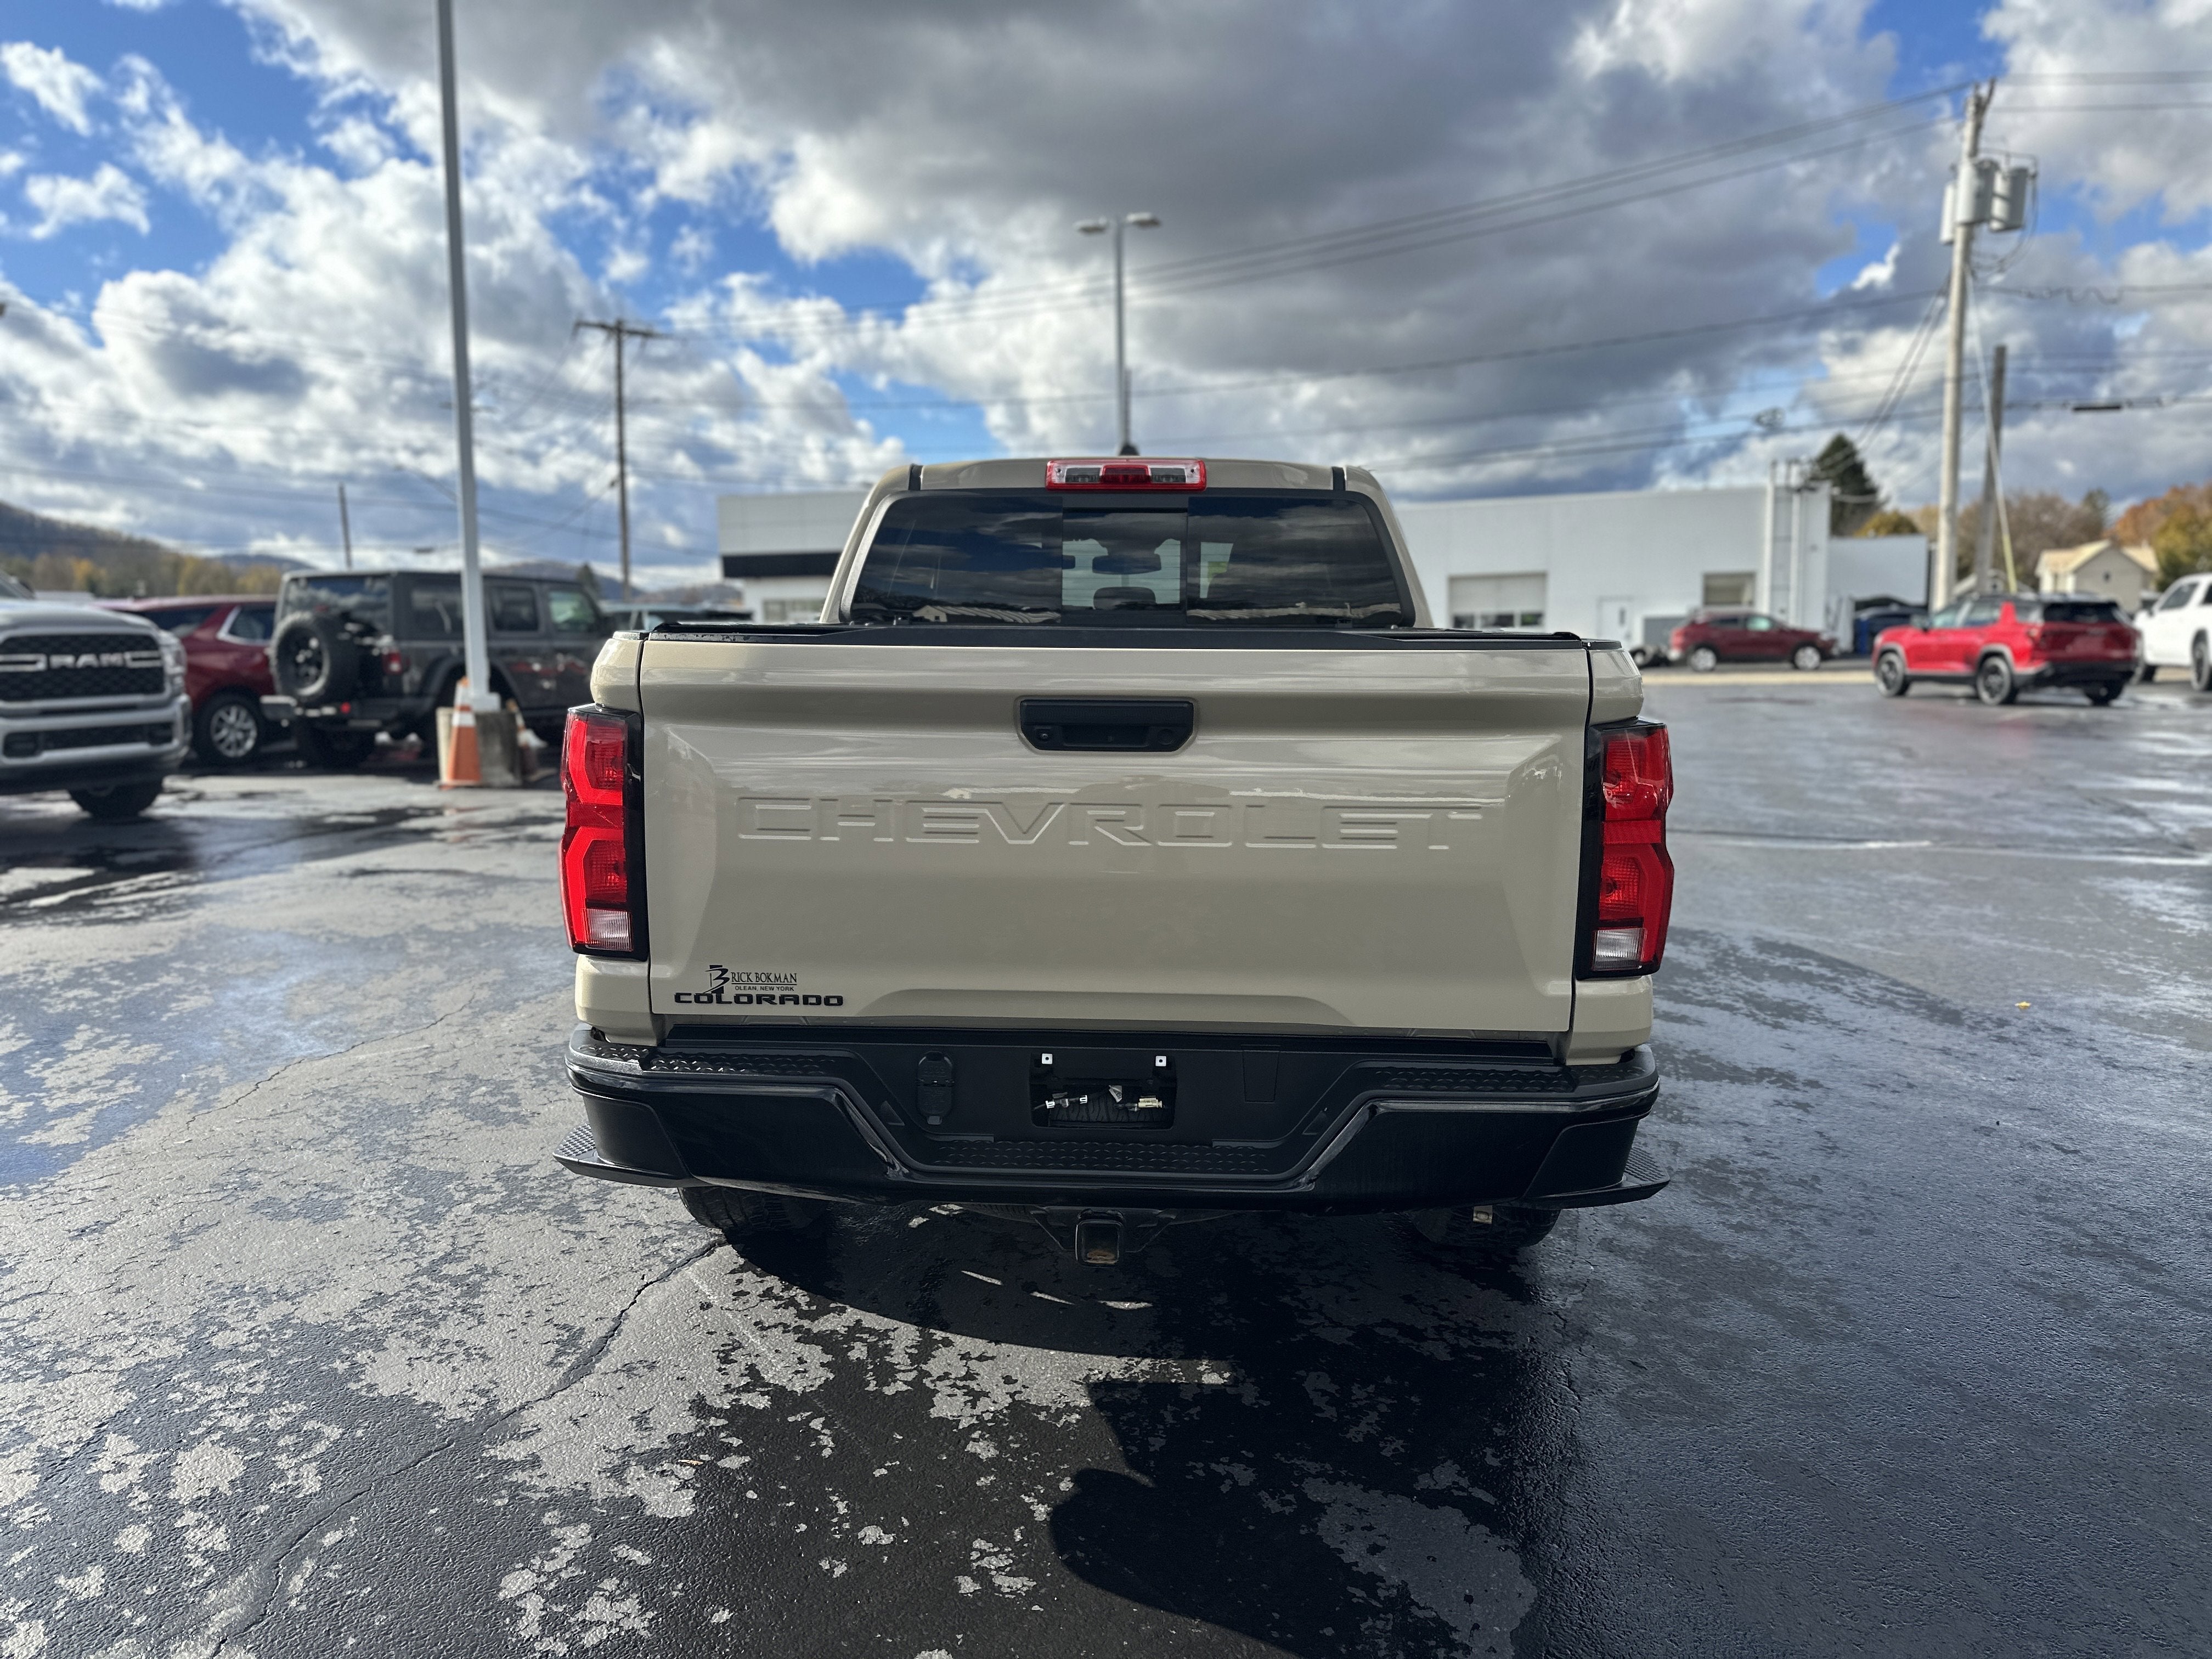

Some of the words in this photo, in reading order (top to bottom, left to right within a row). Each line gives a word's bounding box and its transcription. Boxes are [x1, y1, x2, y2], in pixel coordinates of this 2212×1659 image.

[49, 653, 125, 669] RAM
[738, 795, 1482, 850] CHEVROLET
[731, 972, 752, 983] RICK
[755, 973, 797, 984] BOKMAN
[674, 992, 843, 1006] COLORADO
